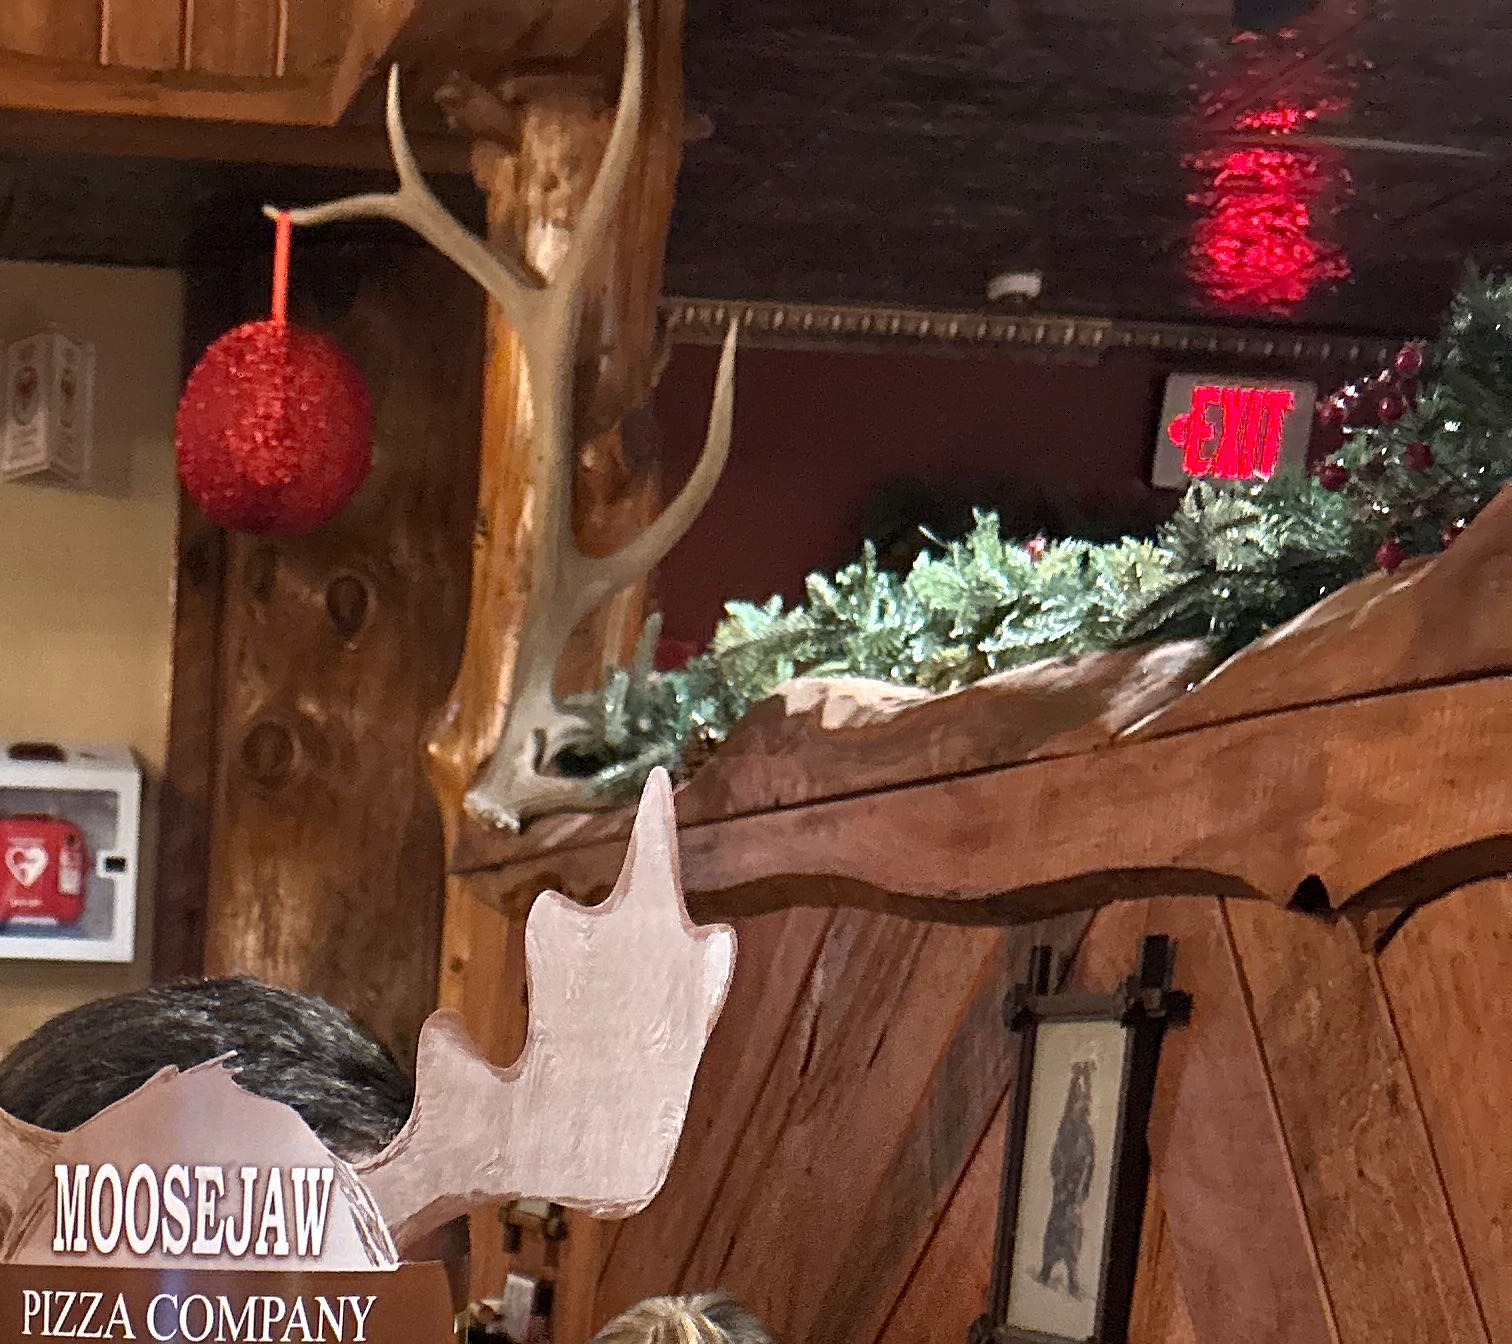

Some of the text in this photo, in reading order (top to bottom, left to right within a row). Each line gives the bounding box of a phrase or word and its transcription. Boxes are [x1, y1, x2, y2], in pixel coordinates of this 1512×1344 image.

[1182, 384, 1295, 482] EXIT
[53, 1163, 334, 1256] MOOSEJAW
[21, 1289, 377, 1343] PIZZA COMPANY
